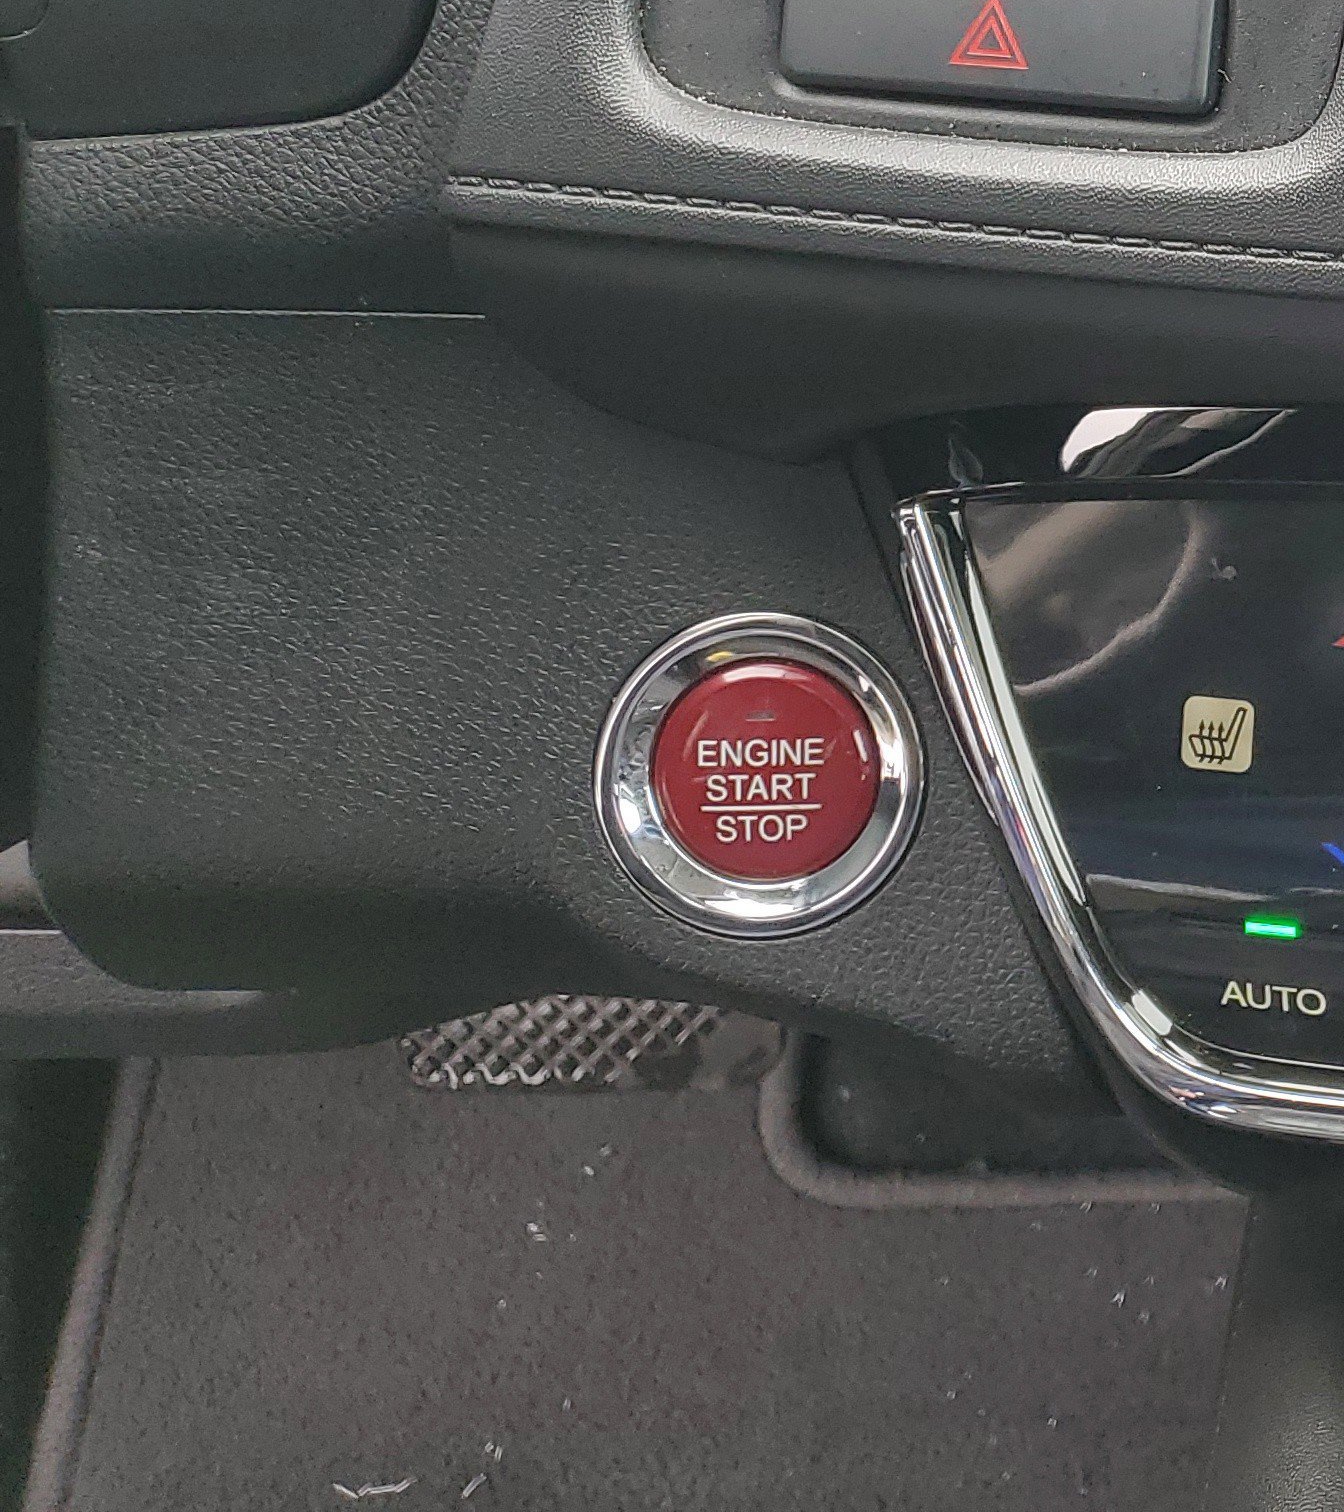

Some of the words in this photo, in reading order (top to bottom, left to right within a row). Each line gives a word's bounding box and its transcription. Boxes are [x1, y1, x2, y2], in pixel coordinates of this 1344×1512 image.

[696, 737, 825, 768] ENGINE
[705, 772, 817, 803] START
[715, 814, 808, 843] STOP
[1220, 980, 1328, 1016] AUTO
